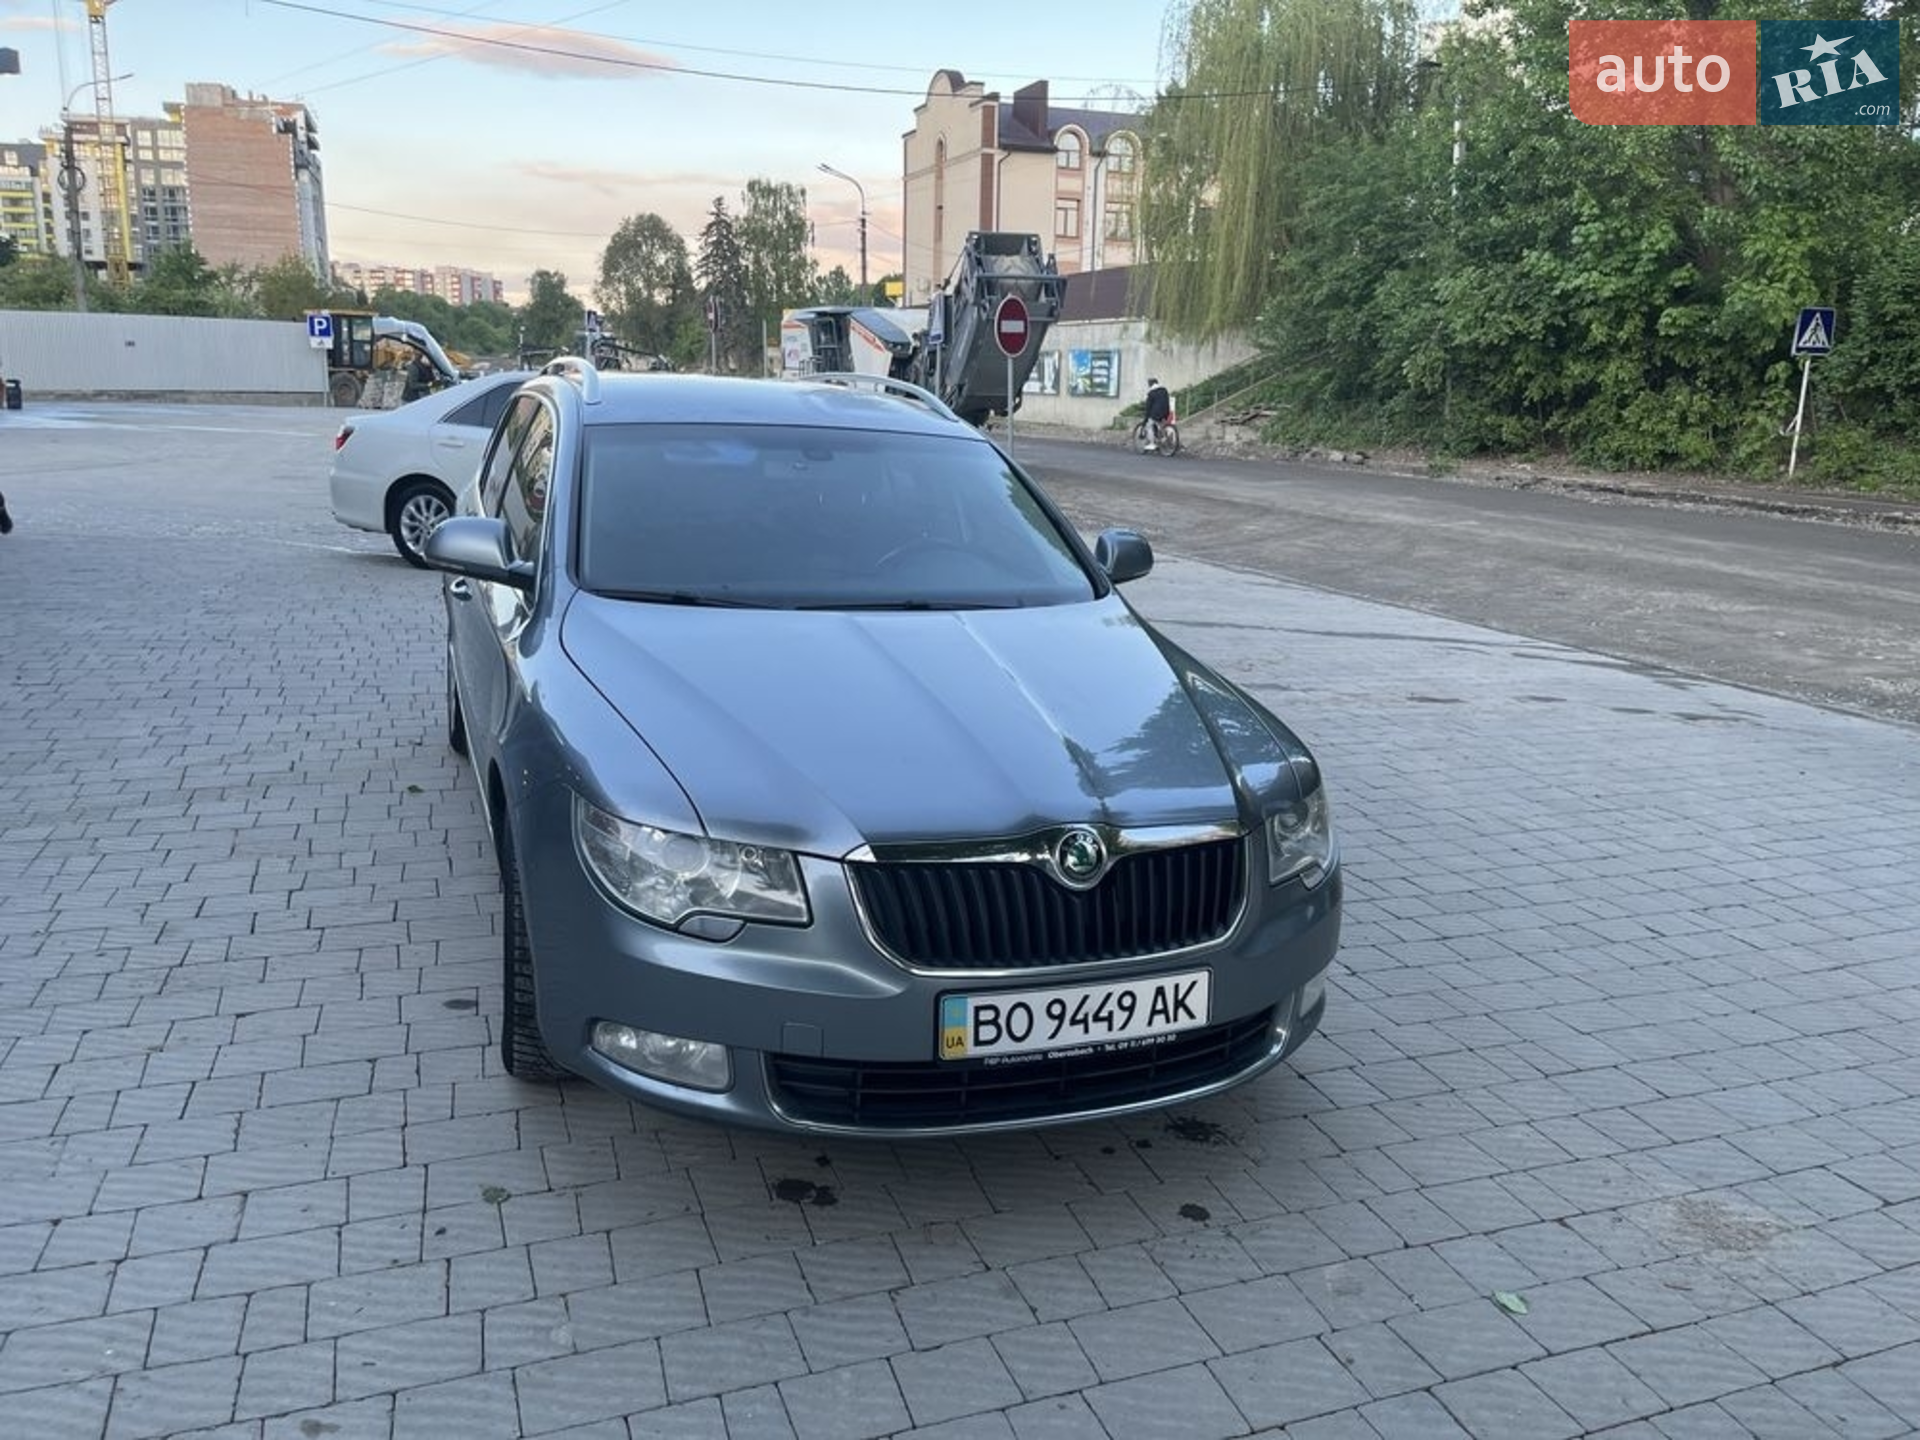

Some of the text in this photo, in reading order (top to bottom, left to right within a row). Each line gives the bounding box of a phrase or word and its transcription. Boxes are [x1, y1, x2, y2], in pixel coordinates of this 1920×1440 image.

[314, 317, 328, 335] P
[973, 980, 1198, 1047] BO 9449 AK
[946, 1034, 965, 1049] UA
